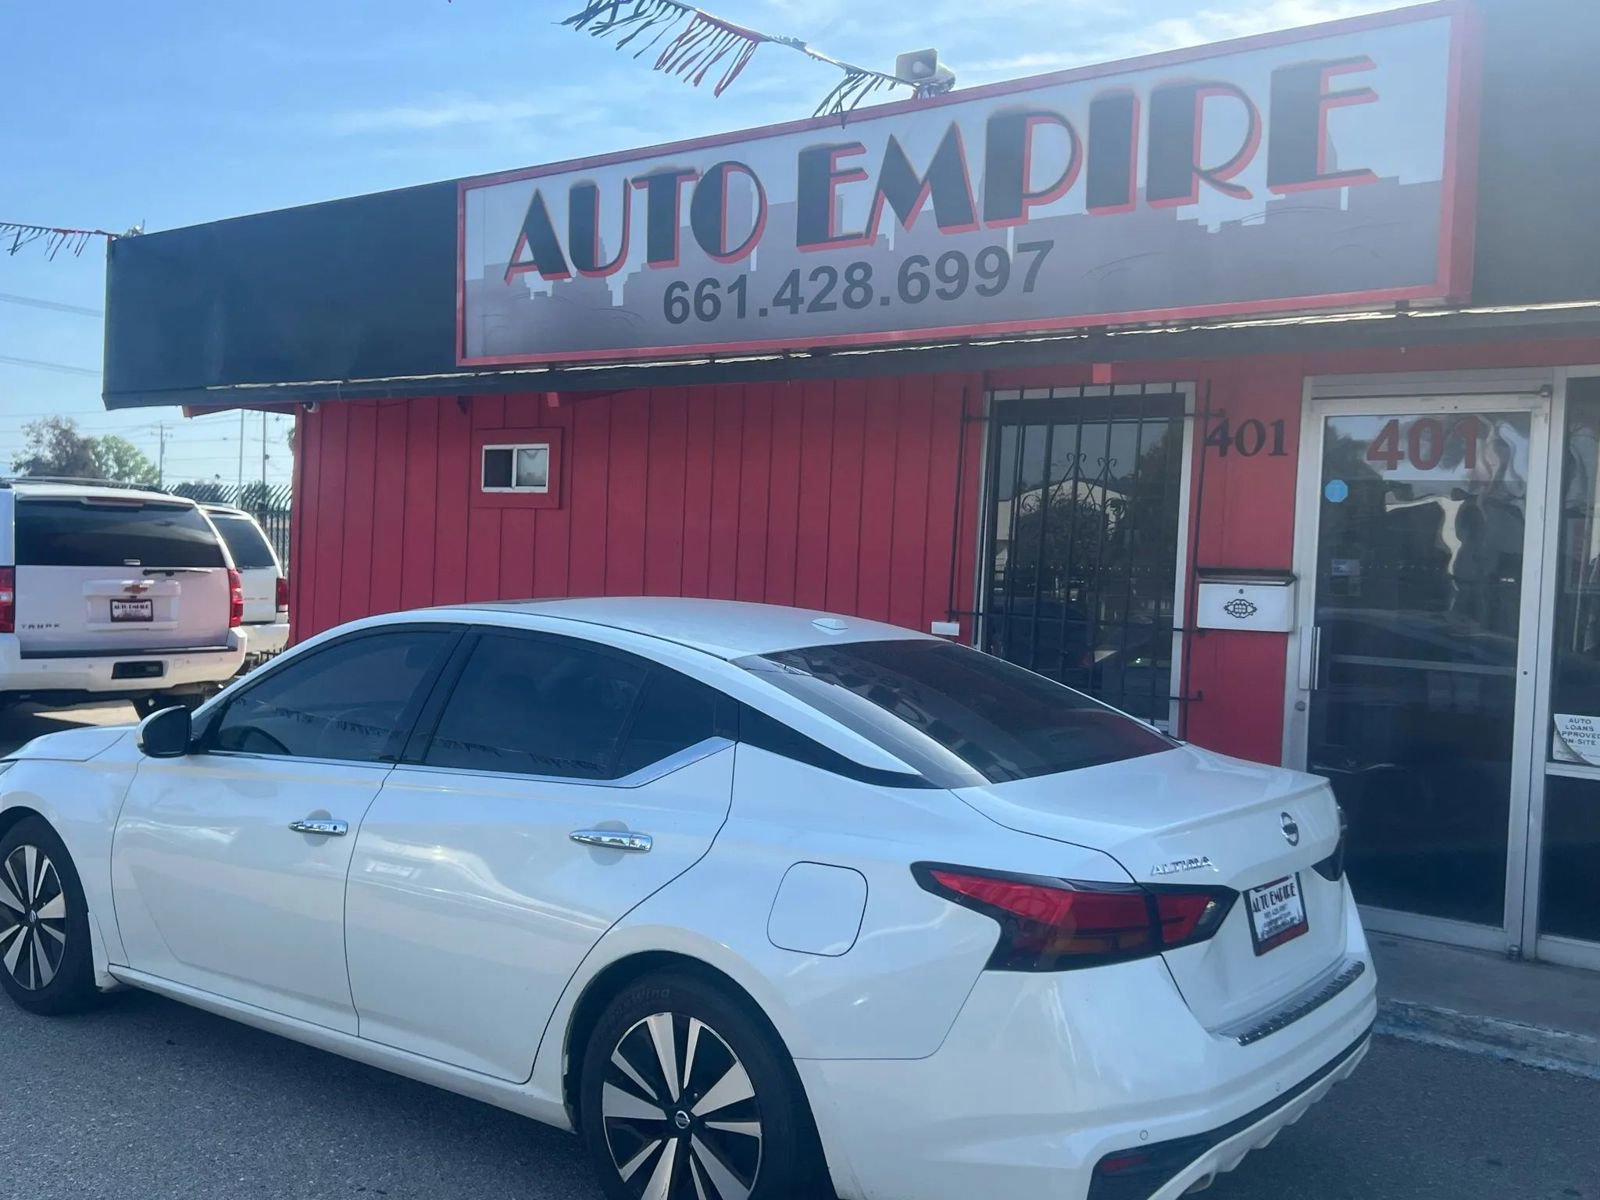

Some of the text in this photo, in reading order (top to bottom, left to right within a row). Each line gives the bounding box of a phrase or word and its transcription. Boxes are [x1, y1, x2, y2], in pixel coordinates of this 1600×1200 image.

[504, 54, 1380, 286] AUTO EMPIRE
[663, 240, 1055, 324] 661.428.6997
[1202, 417, 1288, 457] 401
[1367, 415, 1478, 471] 401
[1561, 731, 1600, 739] PPROVE
[1578, 738, 1597, 746] SITE
